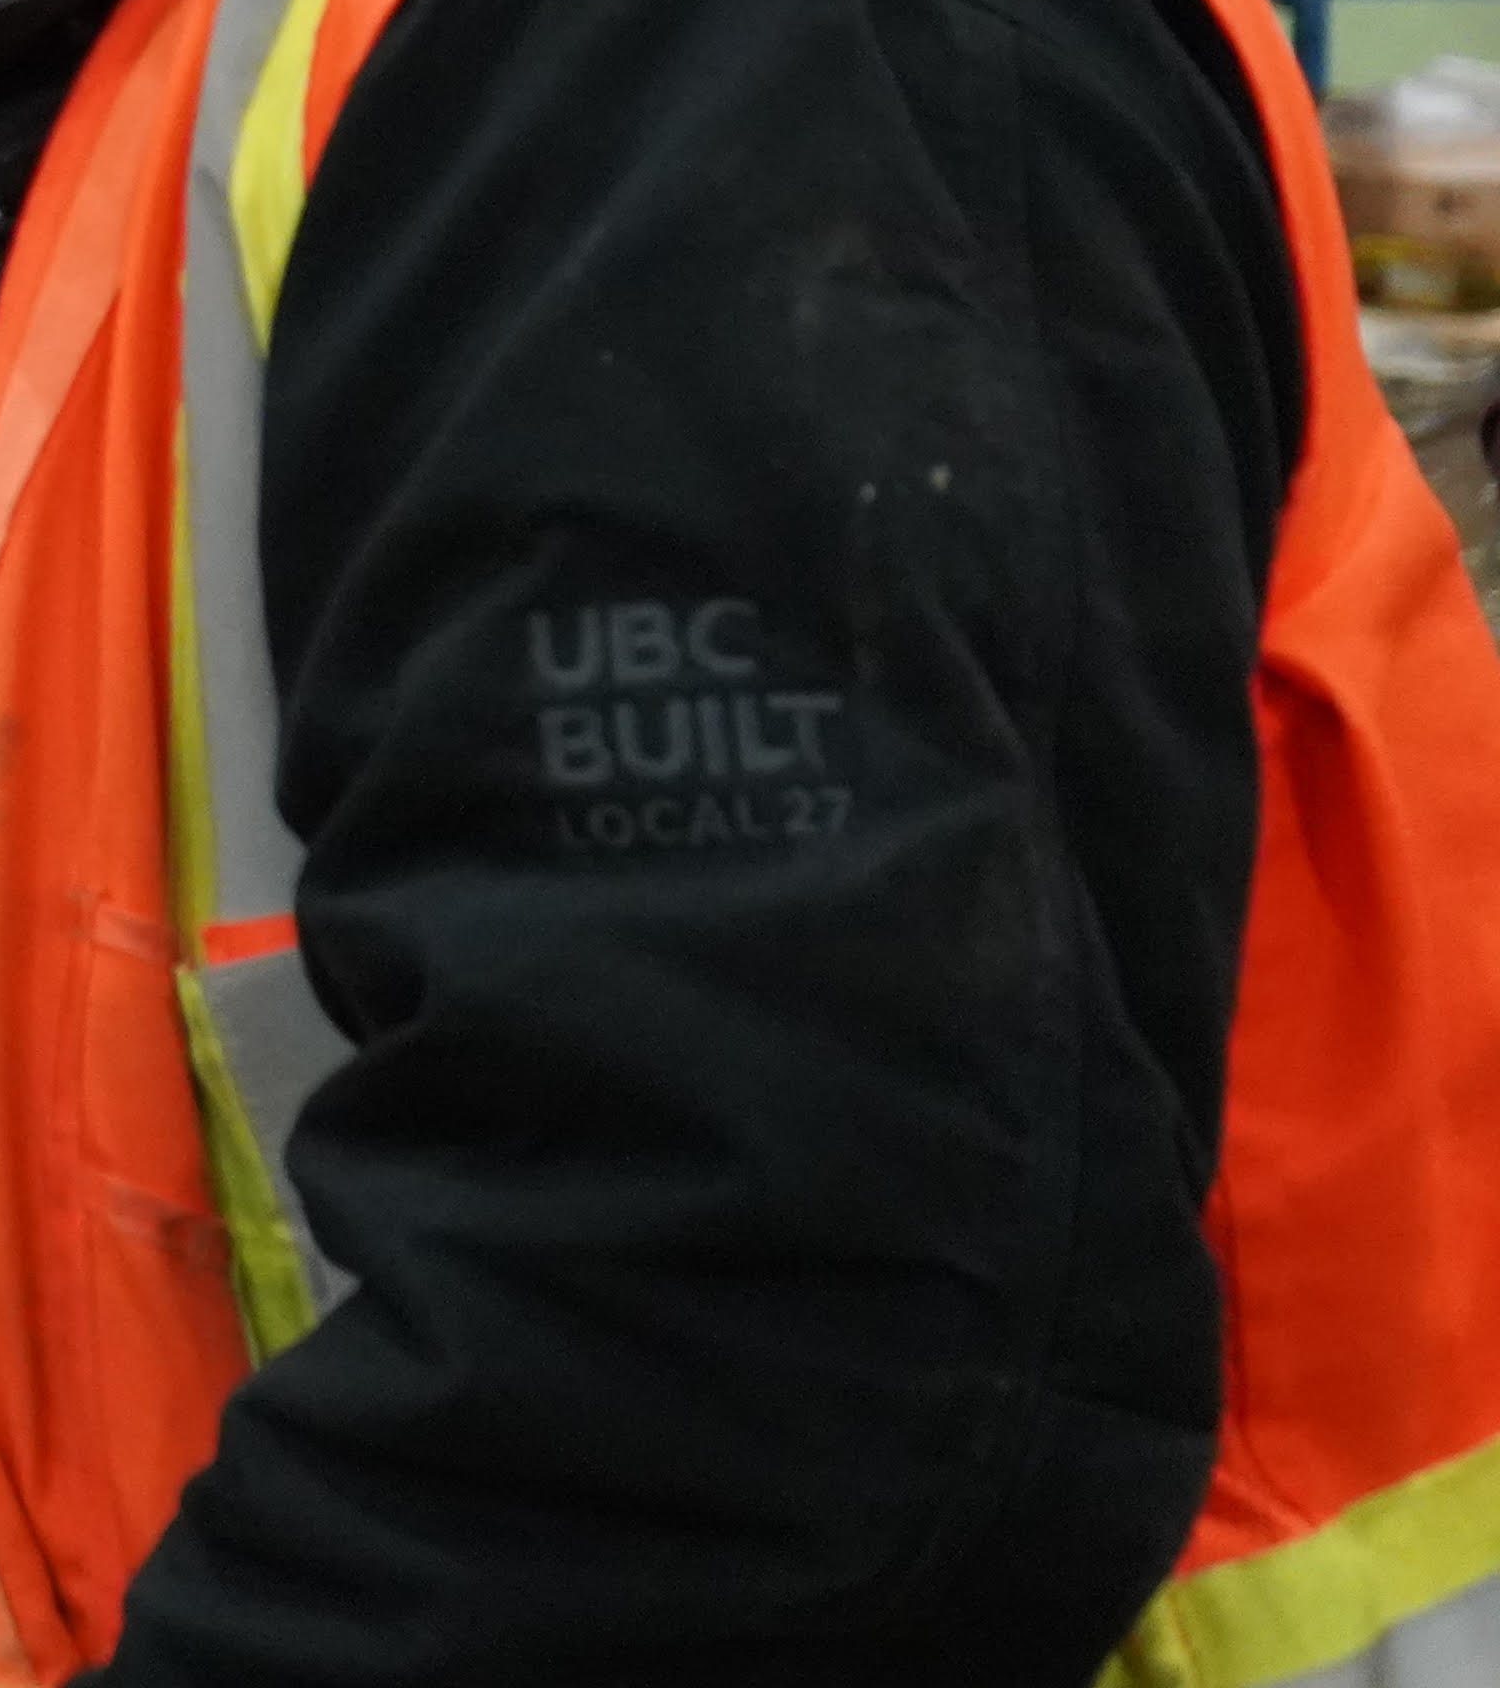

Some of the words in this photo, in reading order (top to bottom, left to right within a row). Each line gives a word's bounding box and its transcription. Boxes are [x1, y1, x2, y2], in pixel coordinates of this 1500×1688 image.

[527, 598, 759, 688] UBC
[537, 689, 846, 784] BUILT
[556, 792, 769, 849] LOCAL
[781, 784, 854, 836] 27
